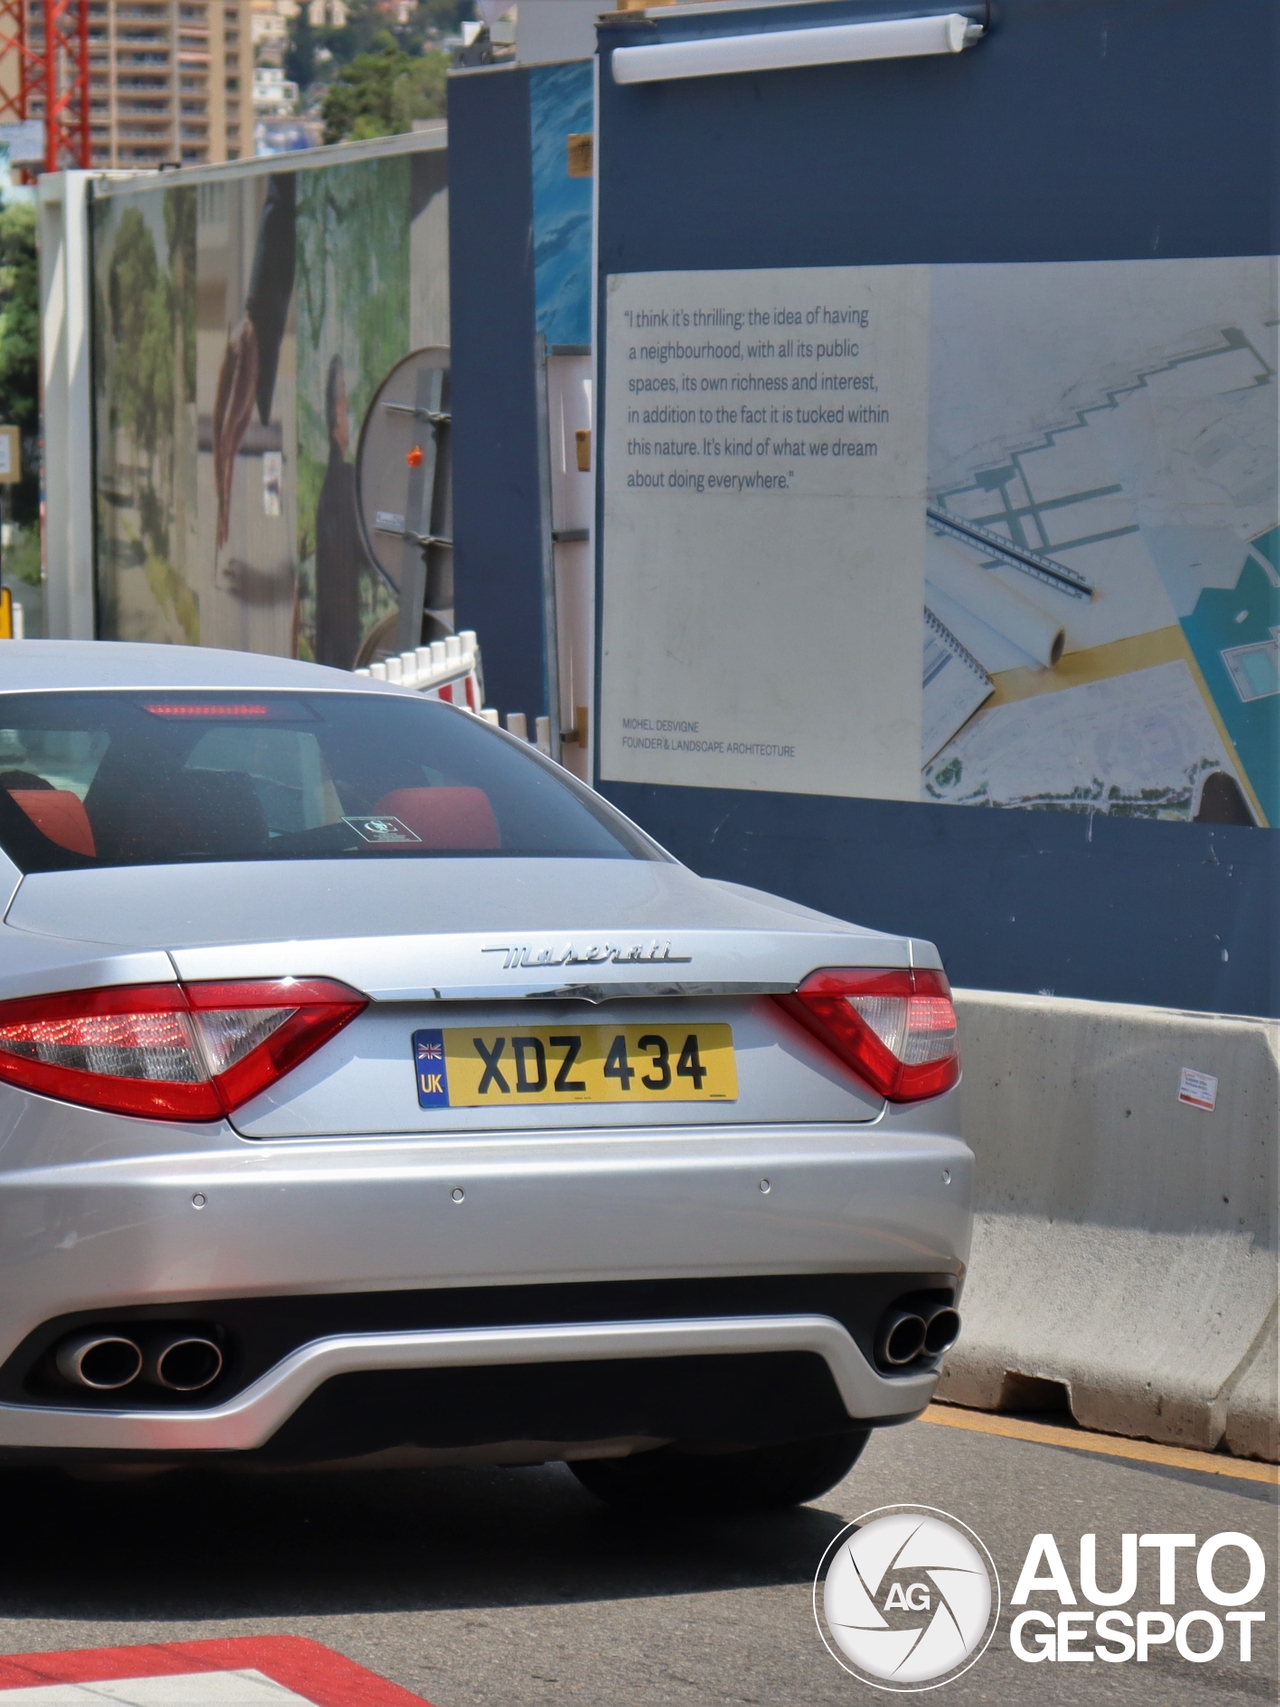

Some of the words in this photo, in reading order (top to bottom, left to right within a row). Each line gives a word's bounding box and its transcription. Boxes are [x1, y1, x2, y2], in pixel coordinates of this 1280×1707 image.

[636, 309, 669, 327] think
[672, 308, 690, 327] it's
[693, 307, 745, 331] thrilling:
[748, 307, 770, 325] the
[773, 307, 803, 325] idea
[806, 305, 821, 324] of
[823, 305, 869, 329] having
[628, 345, 637, 360] a
[640, 340, 744, 364] neighbourhood,
[747, 340, 775, 358] with
[778, 339, 794, 358] all
[797, 339, 813, 358] its
[816, 338, 860, 361] public
[628, 377, 679, 395] spaces,
[681, 373, 697, 391] its
[700, 377, 728, 391] own
[731, 372, 789, 391] richness
[791, 372, 817, 390] and
[821, 372, 878, 392] interest,
[628, 405, 640, 423] in
[643, 405, 696, 423] addition
[699, 407, 713, 423] to
[716, 405, 737, 423] the
[740, 404, 767, 423] fact
[770, 405, 780, 423] it
[782, 405, 793, 423] is
[796, 405, 844, 423] tucked
[847, 404, 889, 423] within
[627, 438, 651, 455] this
[654, 439, 700, 455] nature.
[703, 437, 721, 455] It's
[724, 437, 753, 455] kind
[756, 437, 771, 456] of
[773, 437, 806, 456] what
[809, 442, 828, 456] we
[831, 437, 878, 456] dream
[627, 470, 665, 487] about
[668, 469, 705, 492] doing
[622, 718, 655, 731] MICHEL
[656, 719, 700, 733] DESVIGNE
[622, 736, 663, 750] FOUNDER
[671, 740, 724, 753] LANDSCAPE
[726, 742, 796, 758] ARCHITECTURE
[481, 938, 693, 969] Maserati
[473, 1035, 586, 1094] XDZ
[603, 1034, 707, 1091] 434
[421, 1074, 444, 1093] UK
